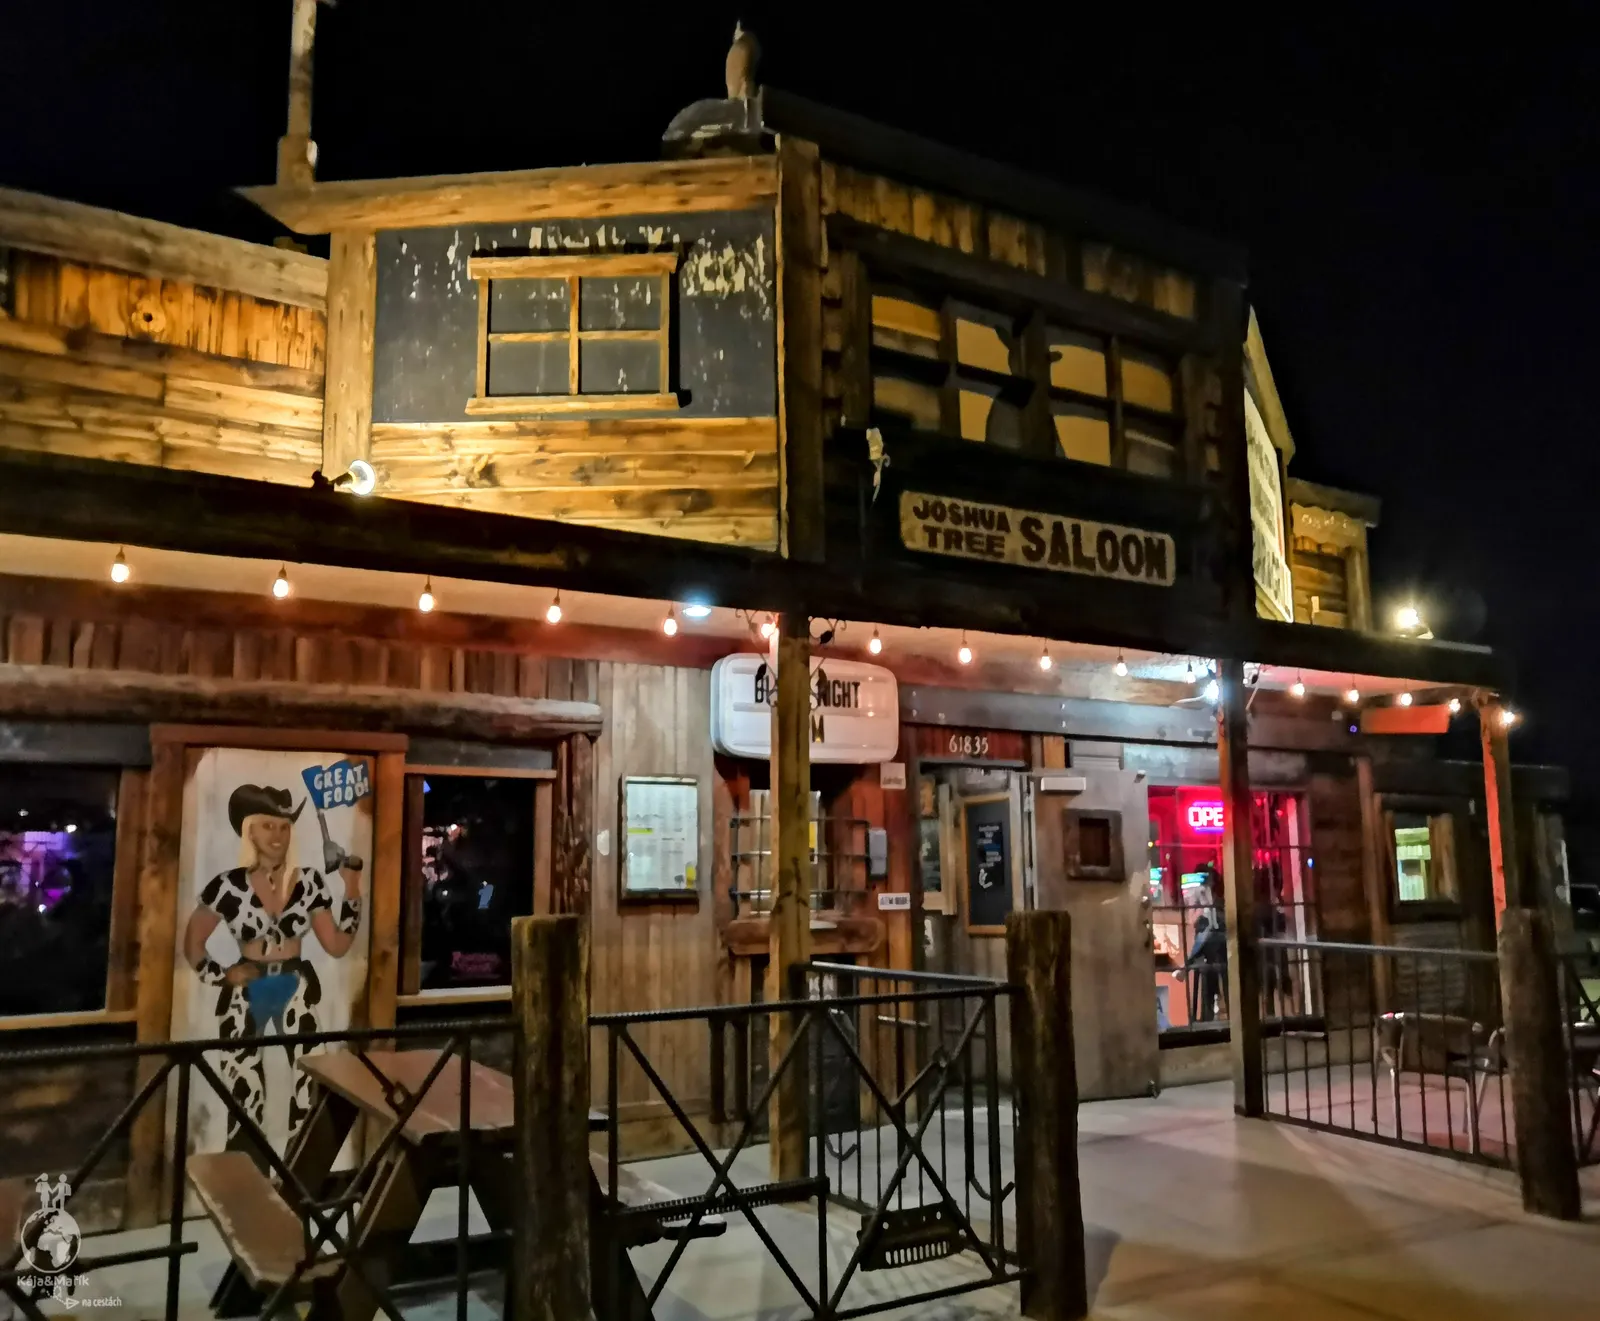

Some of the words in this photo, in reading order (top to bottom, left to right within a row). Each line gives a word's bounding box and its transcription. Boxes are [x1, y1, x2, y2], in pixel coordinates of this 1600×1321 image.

[912, 500, 1011, 533] JOSHUA
[923, 525, 1005, 559] TREE
[1020, 516, 1166, 580] SALOON
[949, 734, 988, 755] 61835
[313, 764, 364, 790] GREAT
[1188, 806, 1224, 827] OPE
